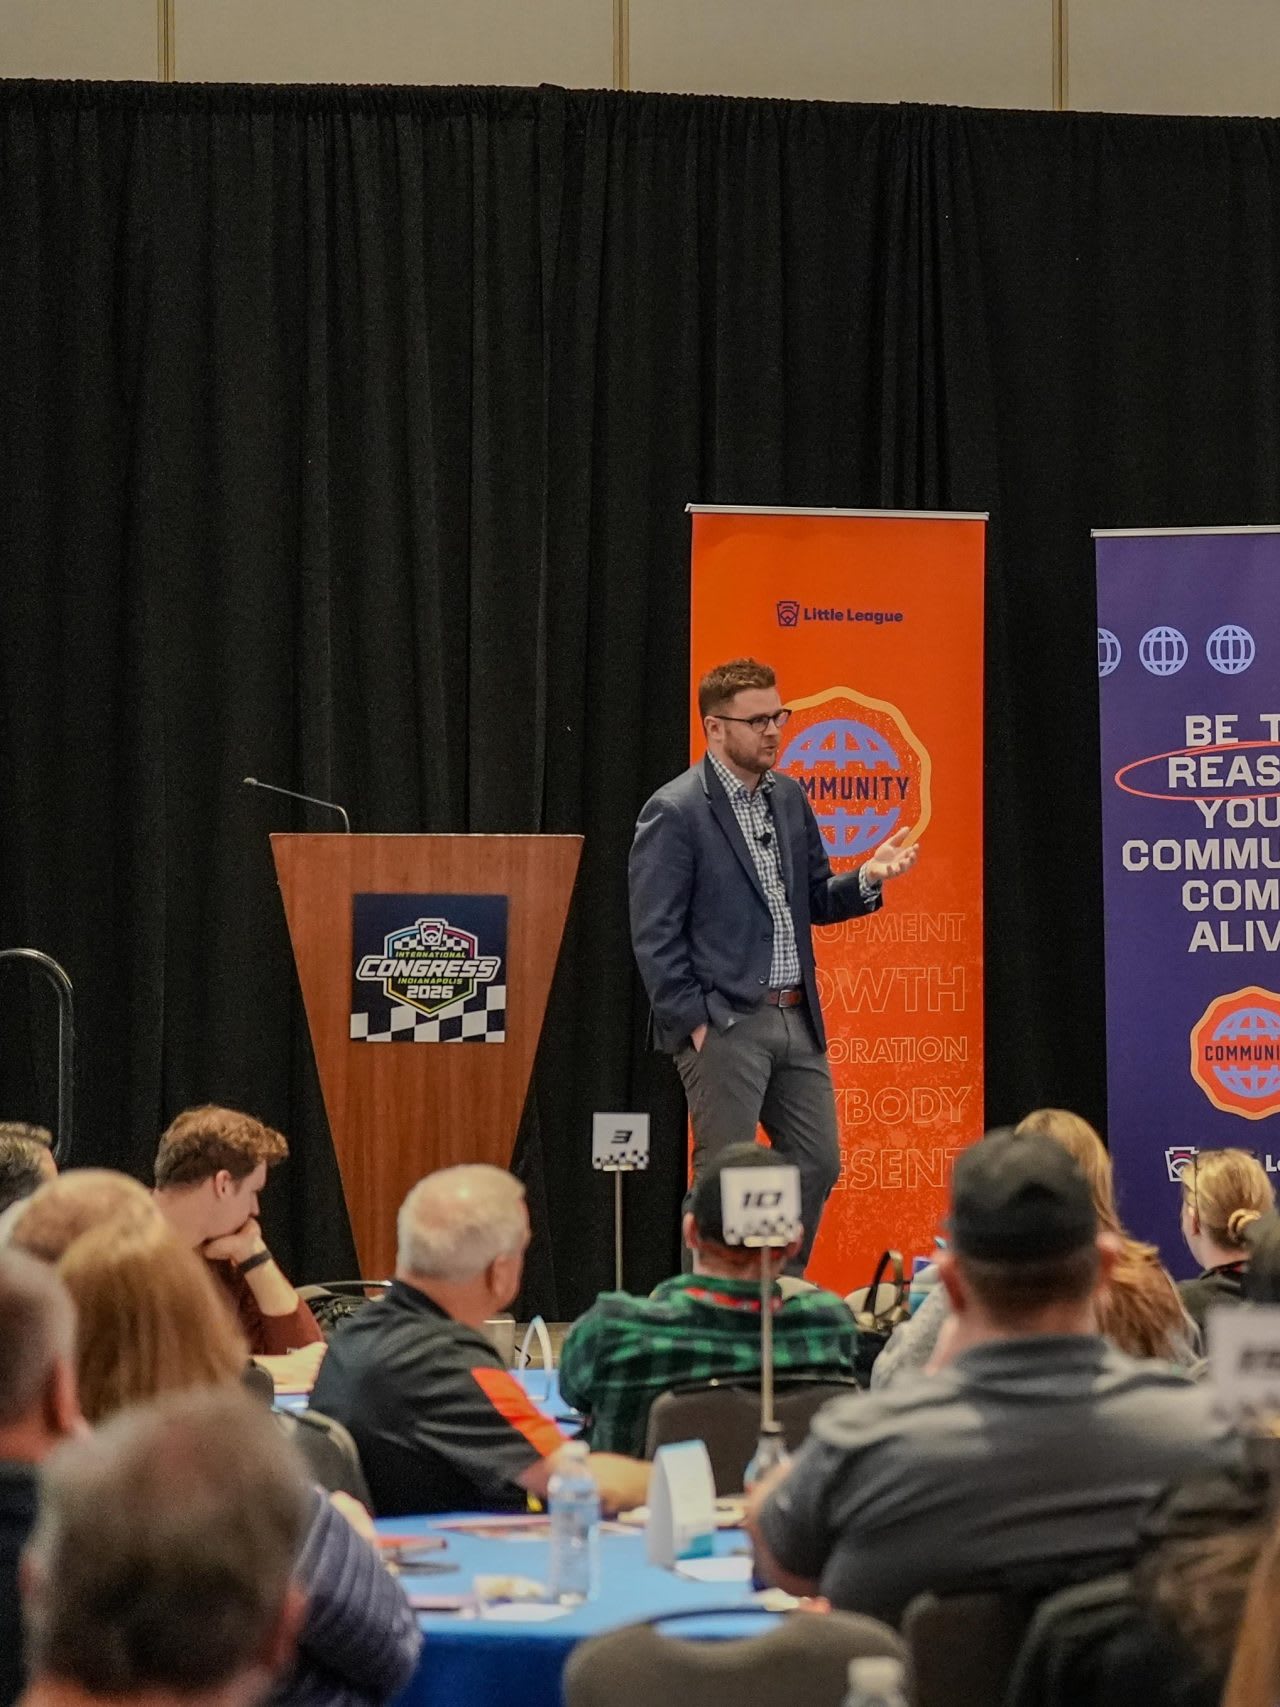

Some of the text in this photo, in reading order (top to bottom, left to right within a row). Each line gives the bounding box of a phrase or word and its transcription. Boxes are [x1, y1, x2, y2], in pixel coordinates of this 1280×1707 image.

[804, 608, 904, 625] Little League
[1185, 714, 1239, 747] BE
[799, 776, 910, 800] MMUNITY
[814, 912, 966, 943] OPMENT
[360, 959, 497, 978] CONGRESS
[407, 985, 454, 999] 2026
[826, 1036, 968, 1064] ORATION
[834, 1086, 972, 1125] BODY
[611, 1129, 633, 1144] 3
